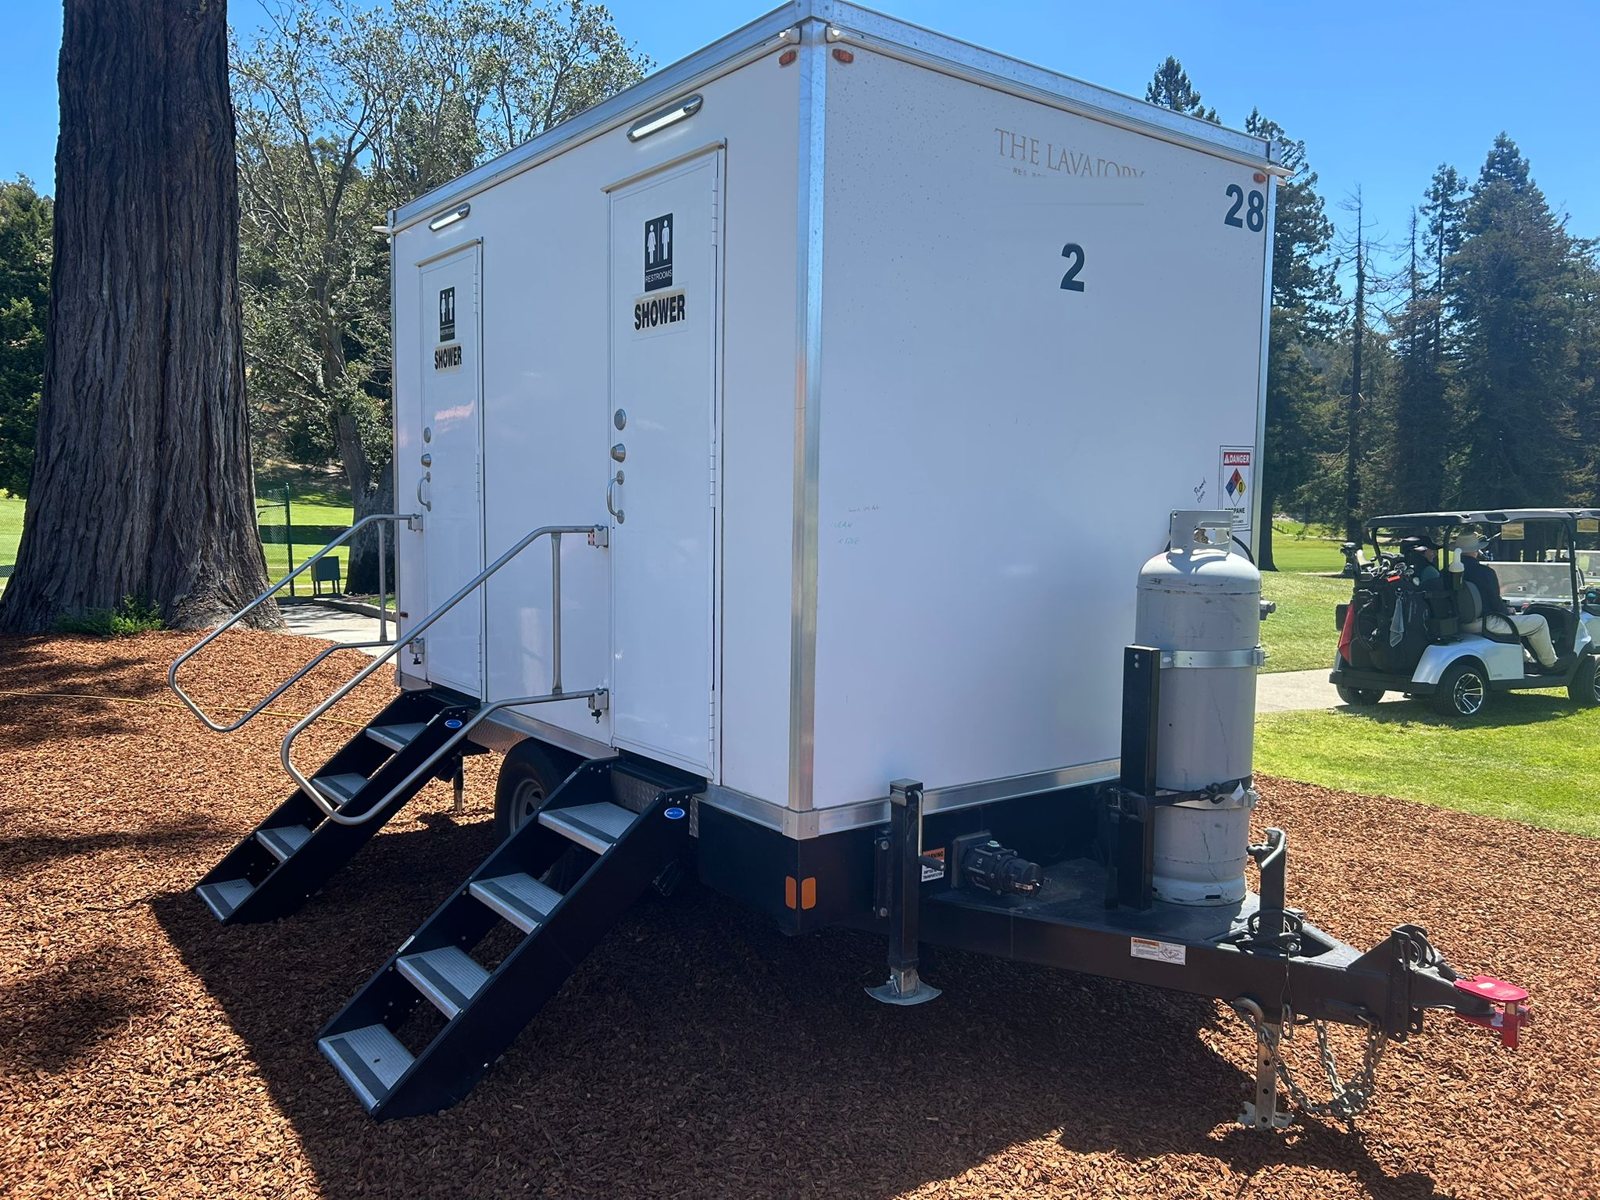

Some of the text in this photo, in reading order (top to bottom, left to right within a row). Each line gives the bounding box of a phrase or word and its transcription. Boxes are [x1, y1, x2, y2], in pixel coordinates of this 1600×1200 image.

[994, 127, 1145, 177] THE LAVATO
[1224, 183, 1265, 233] 28
[645, 269, 672, 282] RESTROOMS
[1060, 242, 1086, 293] 2
[634, 293, 686, 331] SHOWER
[434, 345, 462, 370] SHOWER
[1229, 454, 1249, 463] DANGER
